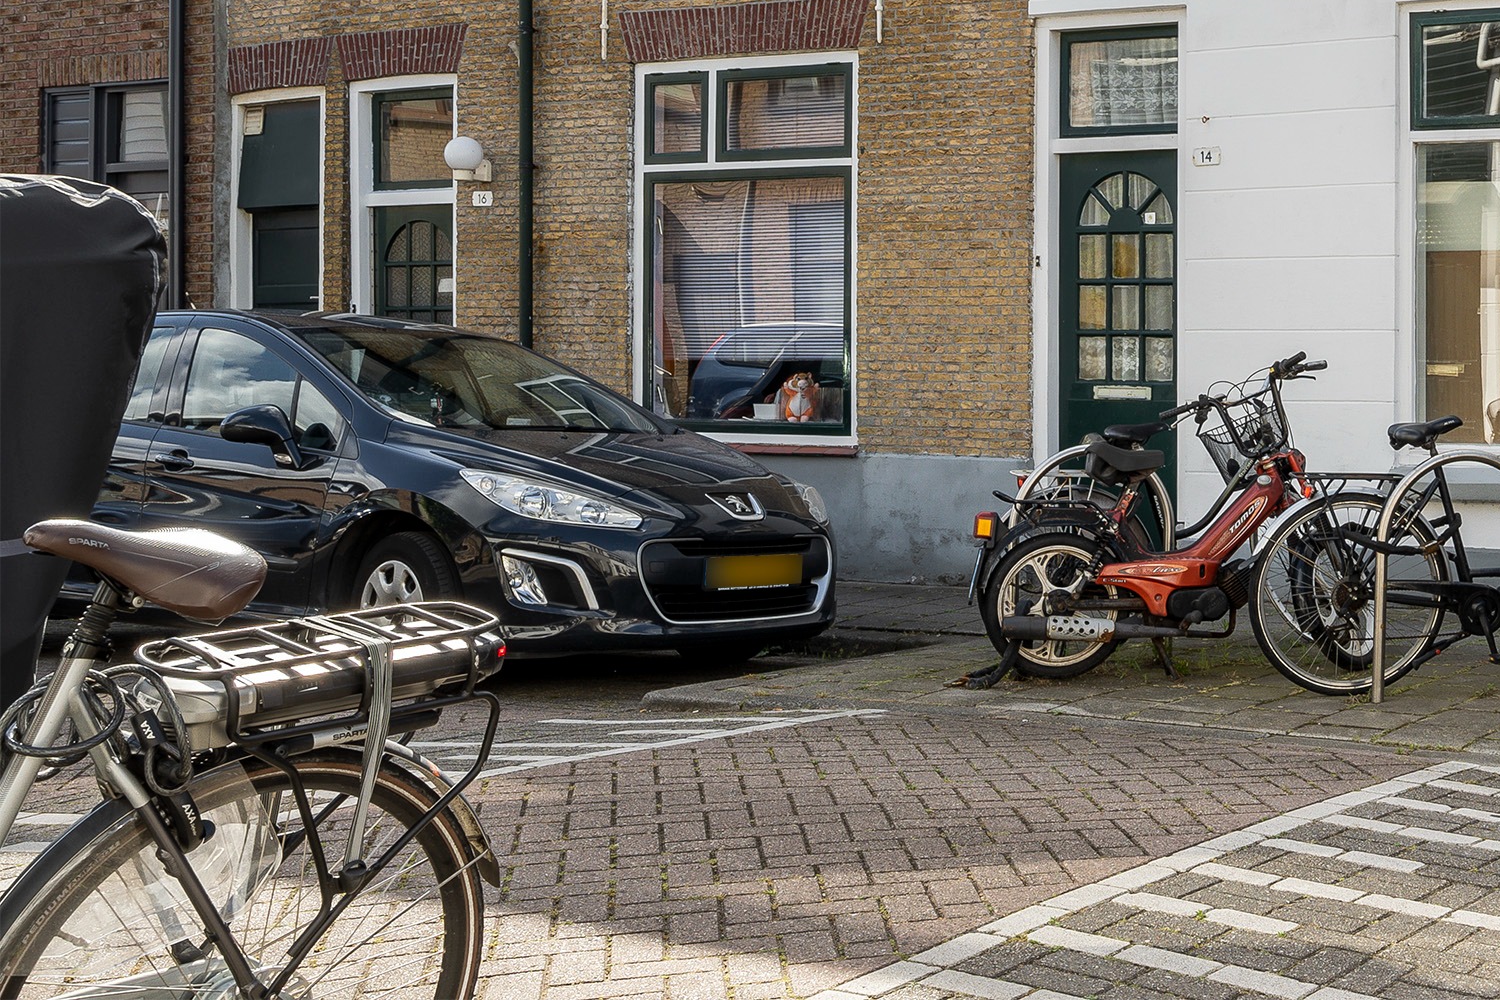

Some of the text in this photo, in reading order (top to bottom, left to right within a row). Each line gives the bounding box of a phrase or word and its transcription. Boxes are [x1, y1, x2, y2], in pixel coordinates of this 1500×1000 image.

[1200, 150, 1212, 163] 14
[477, 193, 487, 204] 16
[1229, 499, 1261, 534] TOMOS
[68, 537, 110, 550] SPARTA
[140, 720, 156, 740] AXA
[182, 804, 197, 824] AXA
